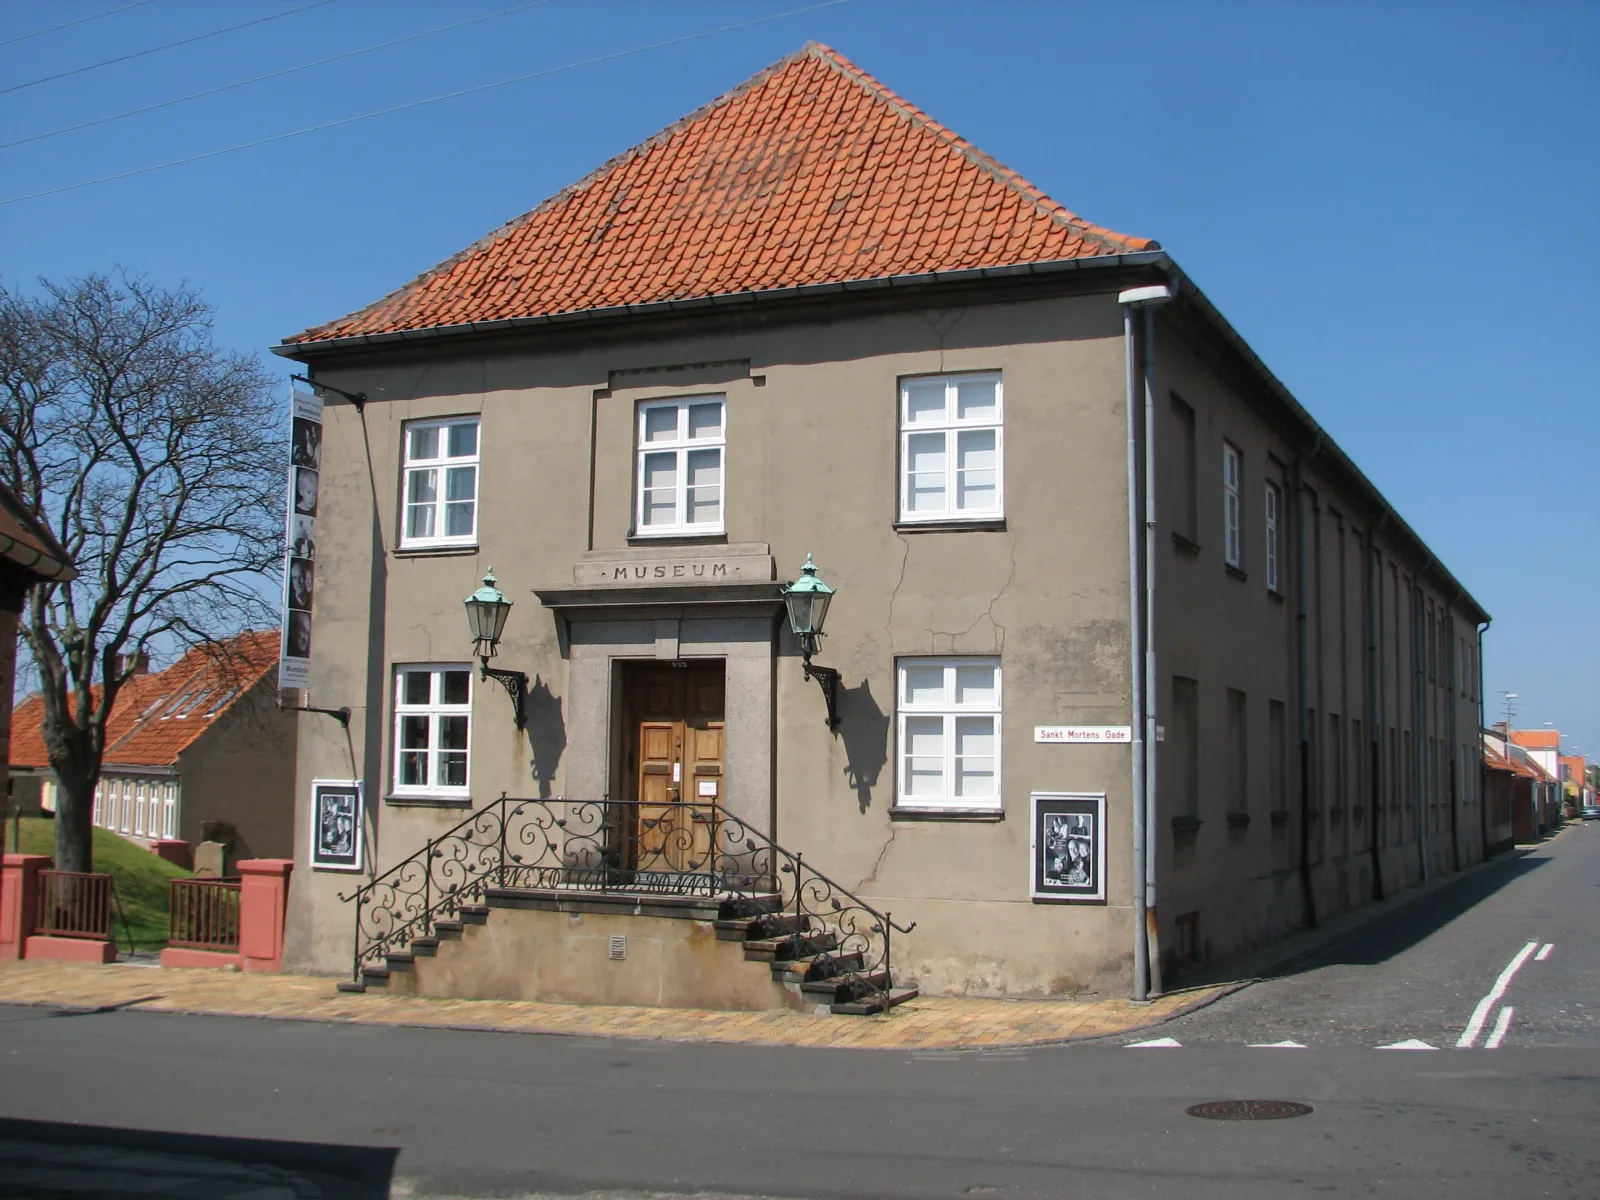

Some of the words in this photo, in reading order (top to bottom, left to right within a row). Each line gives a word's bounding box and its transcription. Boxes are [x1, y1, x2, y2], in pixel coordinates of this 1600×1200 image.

[613, 563, 727, 579] MUSEUM
[1040, 729, 1063, 739] Sankt
[1067, 729, 1100, 739] Mortens
[1105, 729, 1125, 739] Gade
